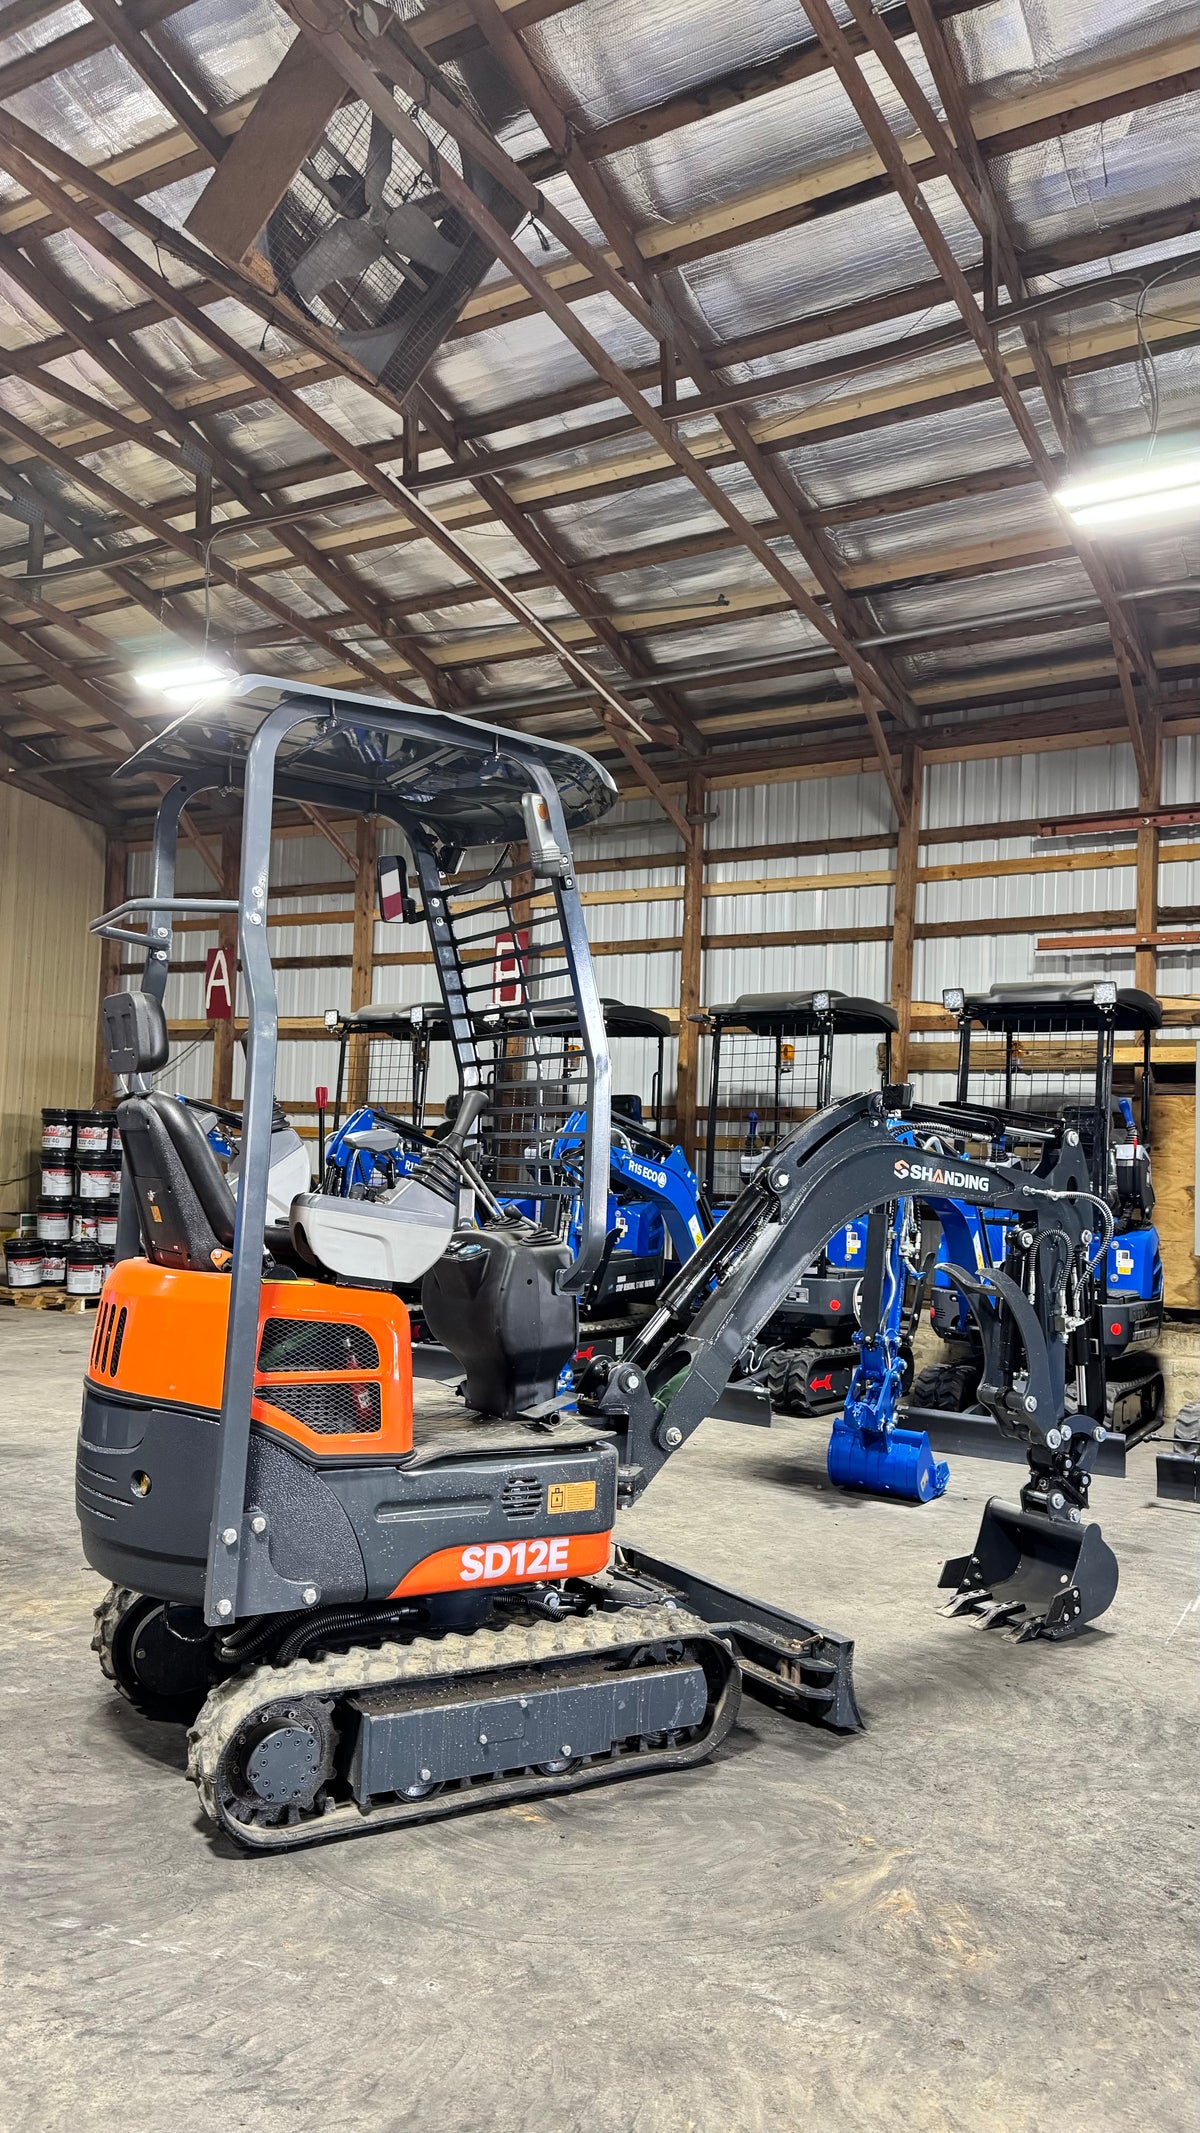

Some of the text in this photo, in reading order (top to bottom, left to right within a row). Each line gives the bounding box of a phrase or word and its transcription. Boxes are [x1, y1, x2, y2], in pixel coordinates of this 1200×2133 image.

[206, 949, 231, 1010] A
[404, 1159, 420, 1172] R1
[628, 1160, 658, 1182] R15 ECO
[910, 1164, 989, 1191] SHANDING
[459, 1538, 570, 1582] SD12E
